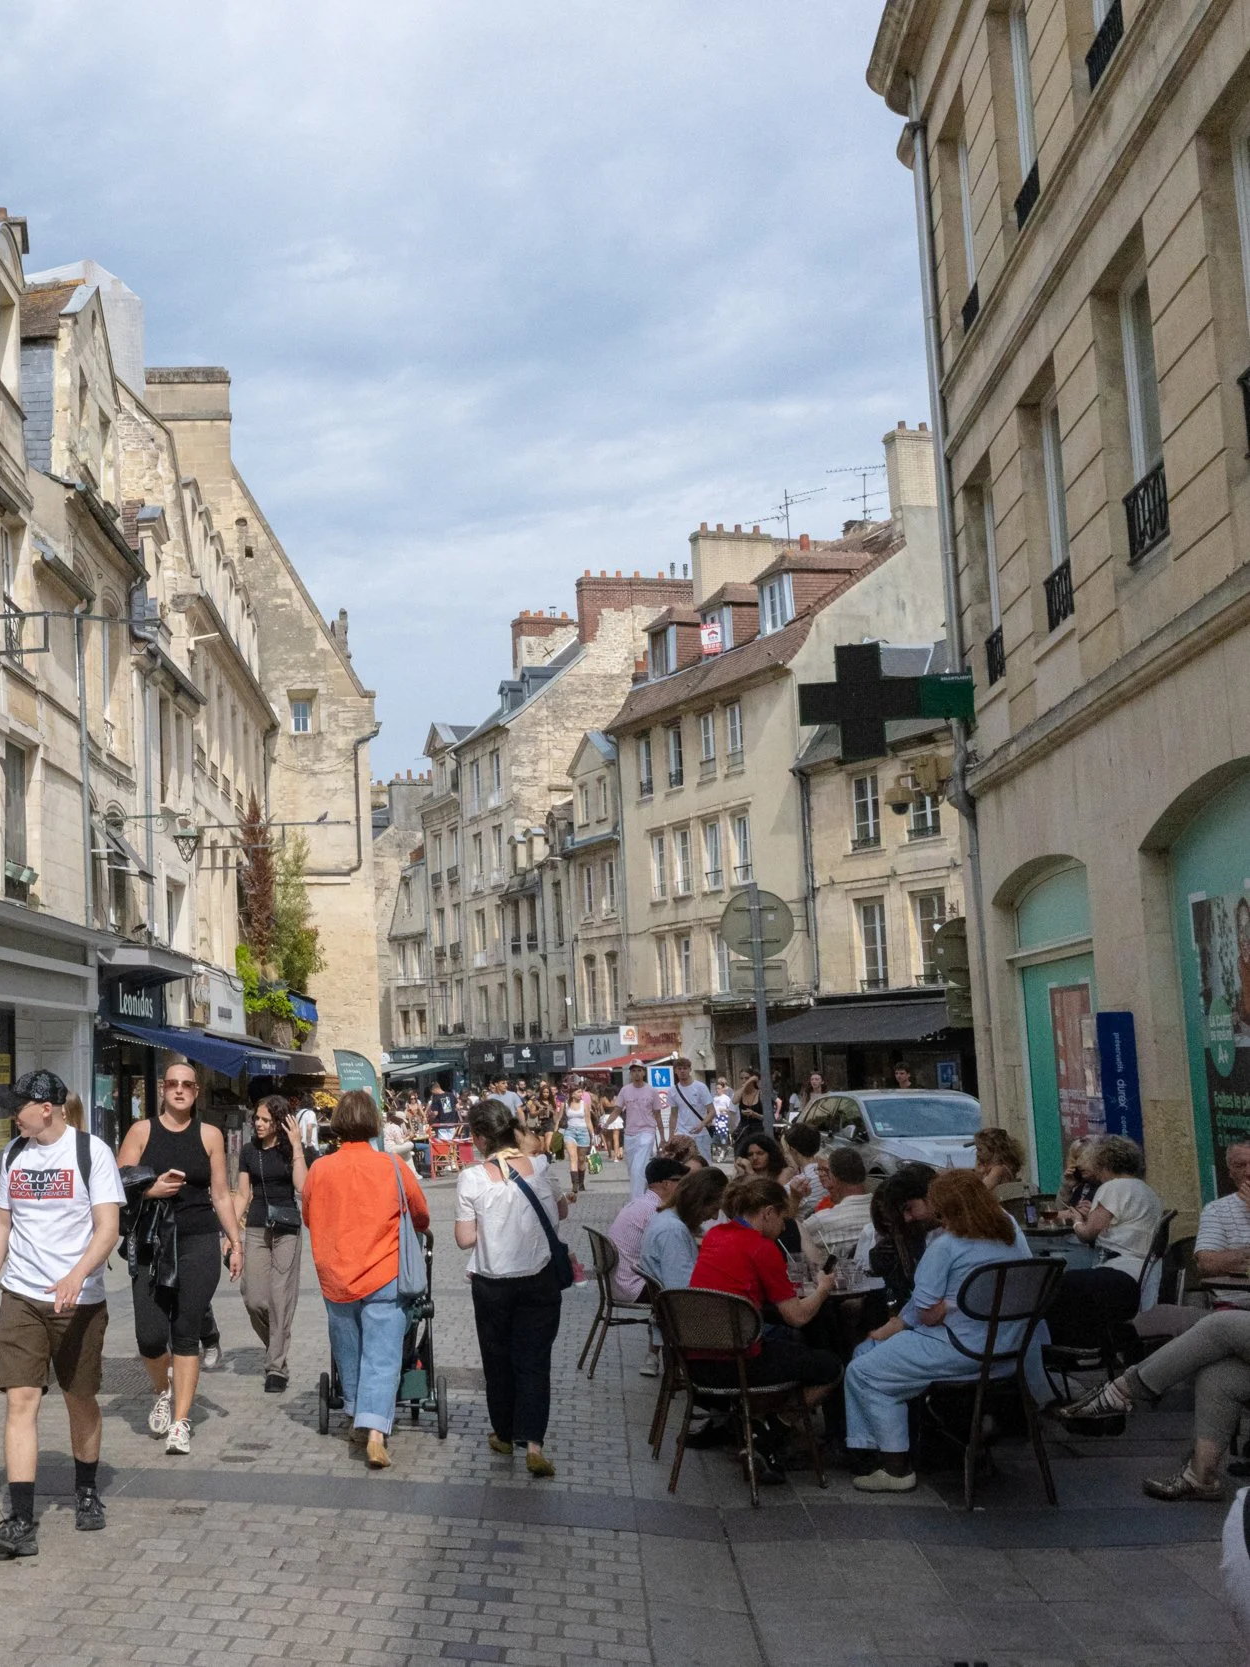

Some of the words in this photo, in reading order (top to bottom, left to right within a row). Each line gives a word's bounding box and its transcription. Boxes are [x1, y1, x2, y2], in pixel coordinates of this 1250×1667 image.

[118, 982, 154, 1019] Leonidas
[1116, 1078, 1128, 1110] durex
[10, 1182, 70, 1192] EXCLUSIVE
[12, 1171, 65, 1183] VOLUME
